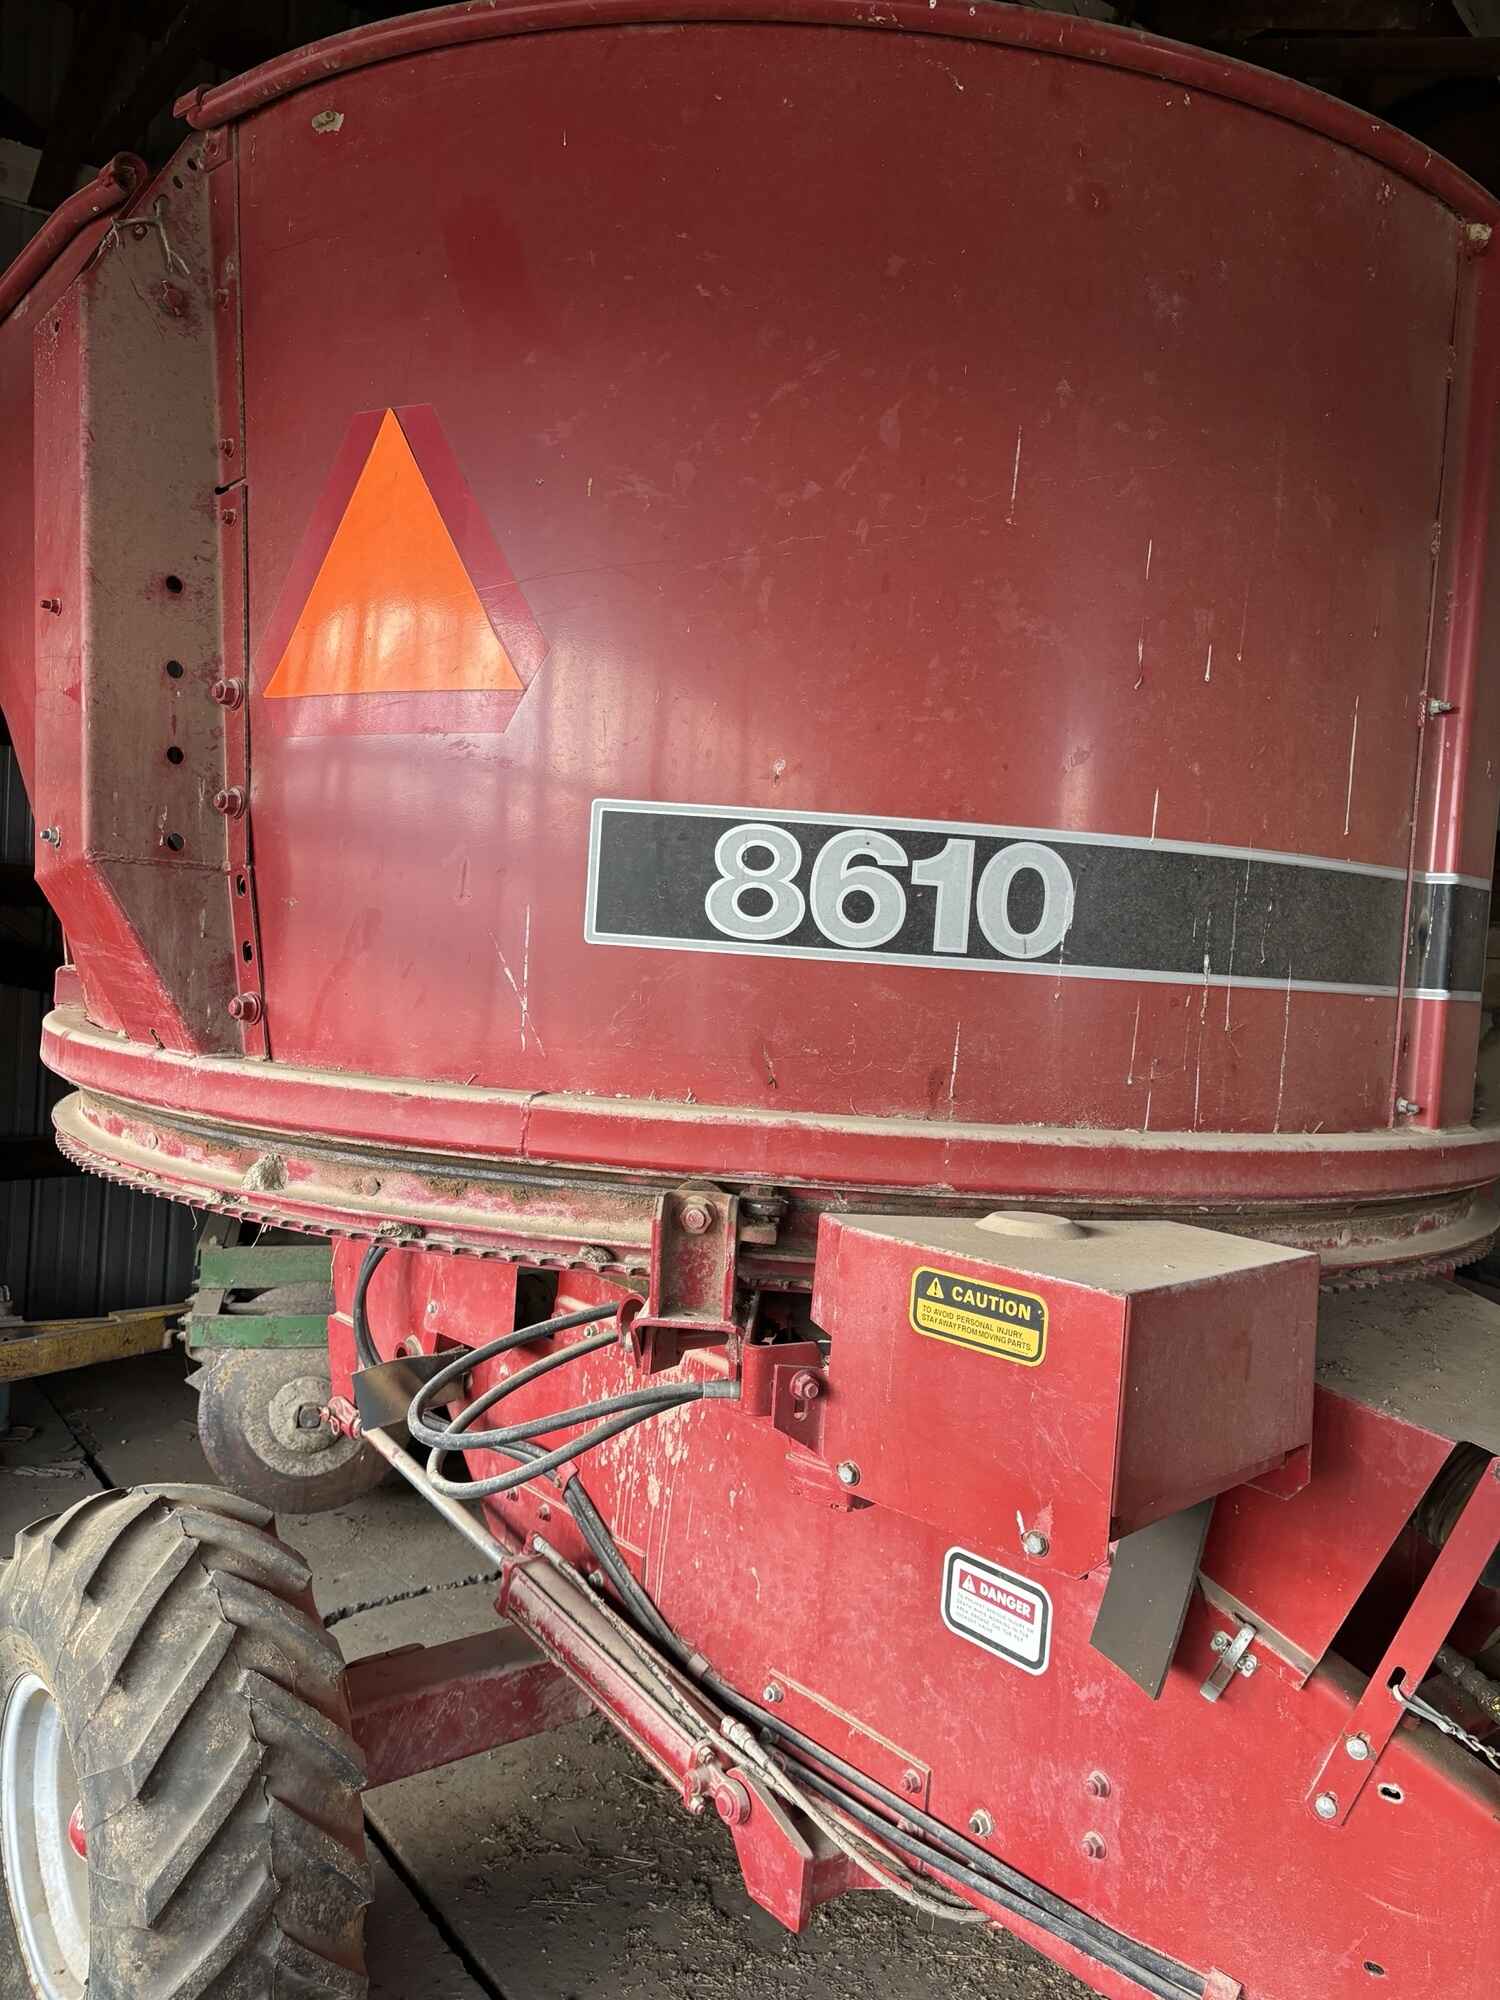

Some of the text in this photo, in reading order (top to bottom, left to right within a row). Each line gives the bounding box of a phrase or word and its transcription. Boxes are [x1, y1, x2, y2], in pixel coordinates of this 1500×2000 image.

[705, 823, 1075, 959] 8610
[923, 1304, 932, 1314] TO
[934, 1308, 954, 1320] AVOID
[957, 1314, 993, 1332] PERSONAL
[951, 1286, 1031, 1321] CAUTION
[921, 1312, 938, 1324] STAY
[939, 1318, 957, 1329] AWAY
[957, 1323, 977, 1336] FROM
[978, 1329, 1007, 1345] MOVING
[1007, 1337, 1033, 1352] PARTS.
[979, 1581, 1031, 1619] DANGER
